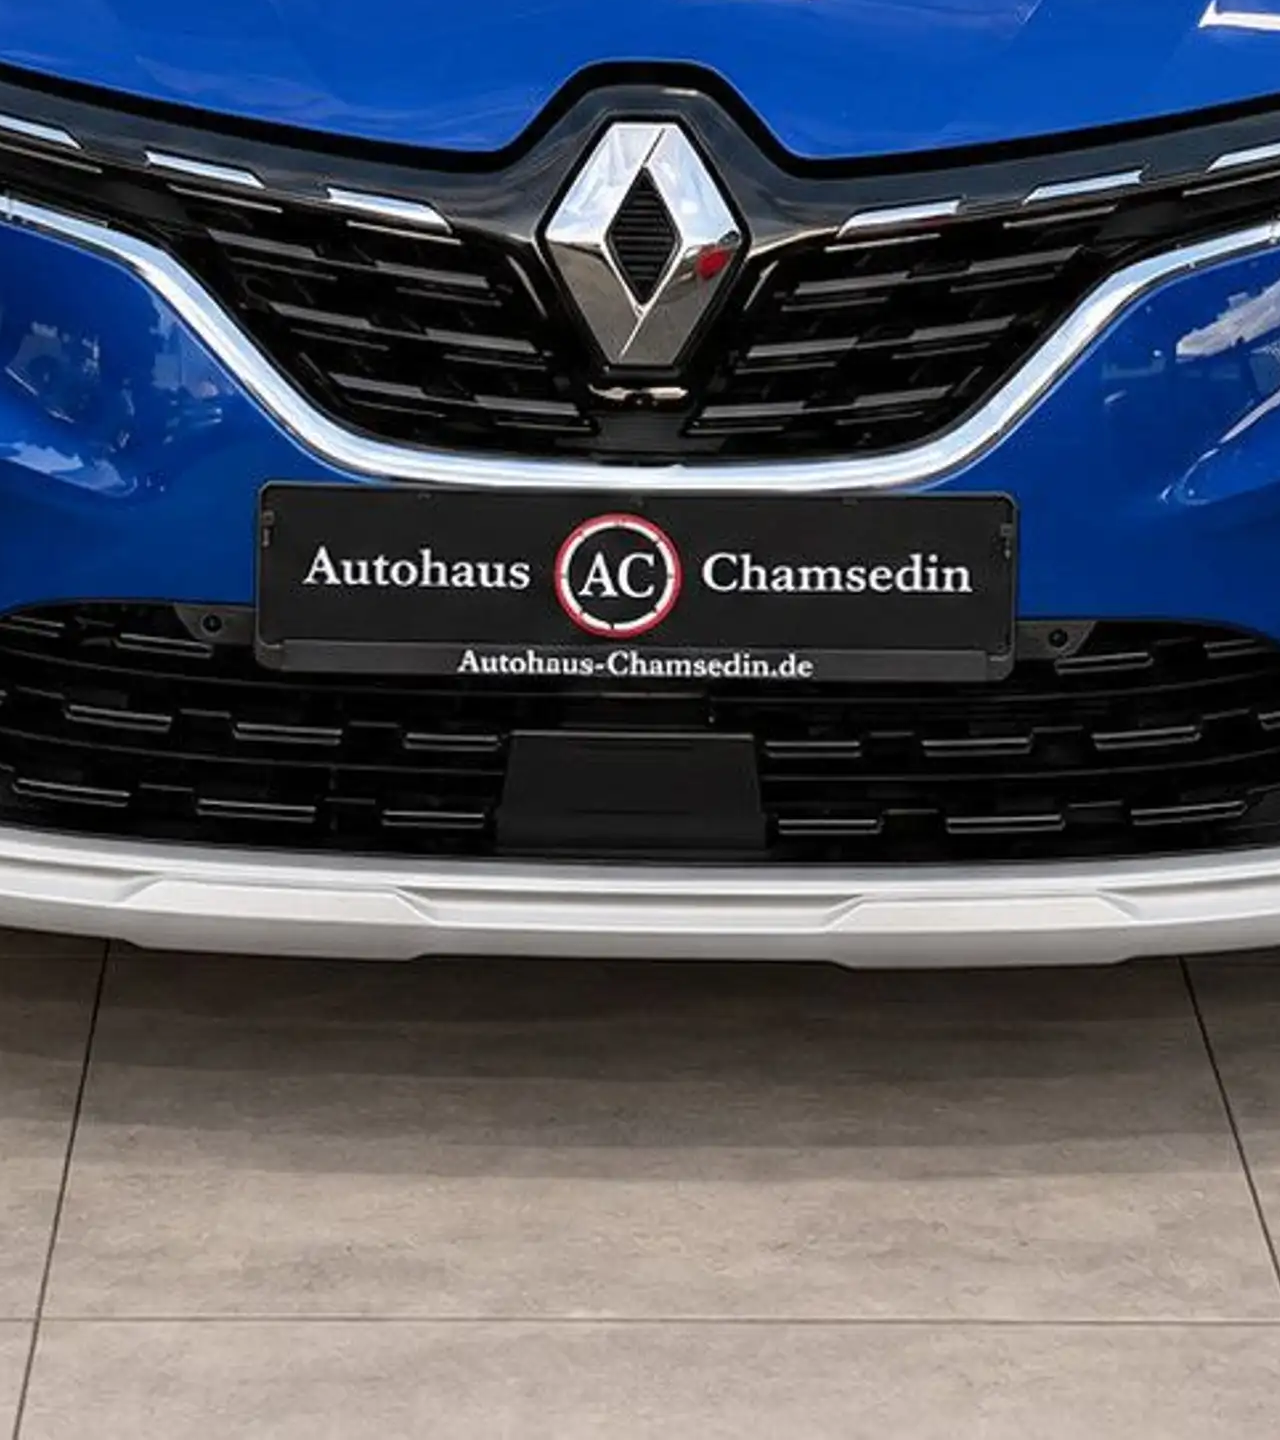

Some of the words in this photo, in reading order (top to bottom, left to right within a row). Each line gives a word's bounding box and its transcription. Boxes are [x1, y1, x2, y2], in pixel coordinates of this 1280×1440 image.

[302, 546, 530, 590] Autohaus
[577, 552, 656, 600] AC
[702, 552, 973, 594] Chamsedin
[457, 649, 814, 679] Autohaus-Chamsedin.de
